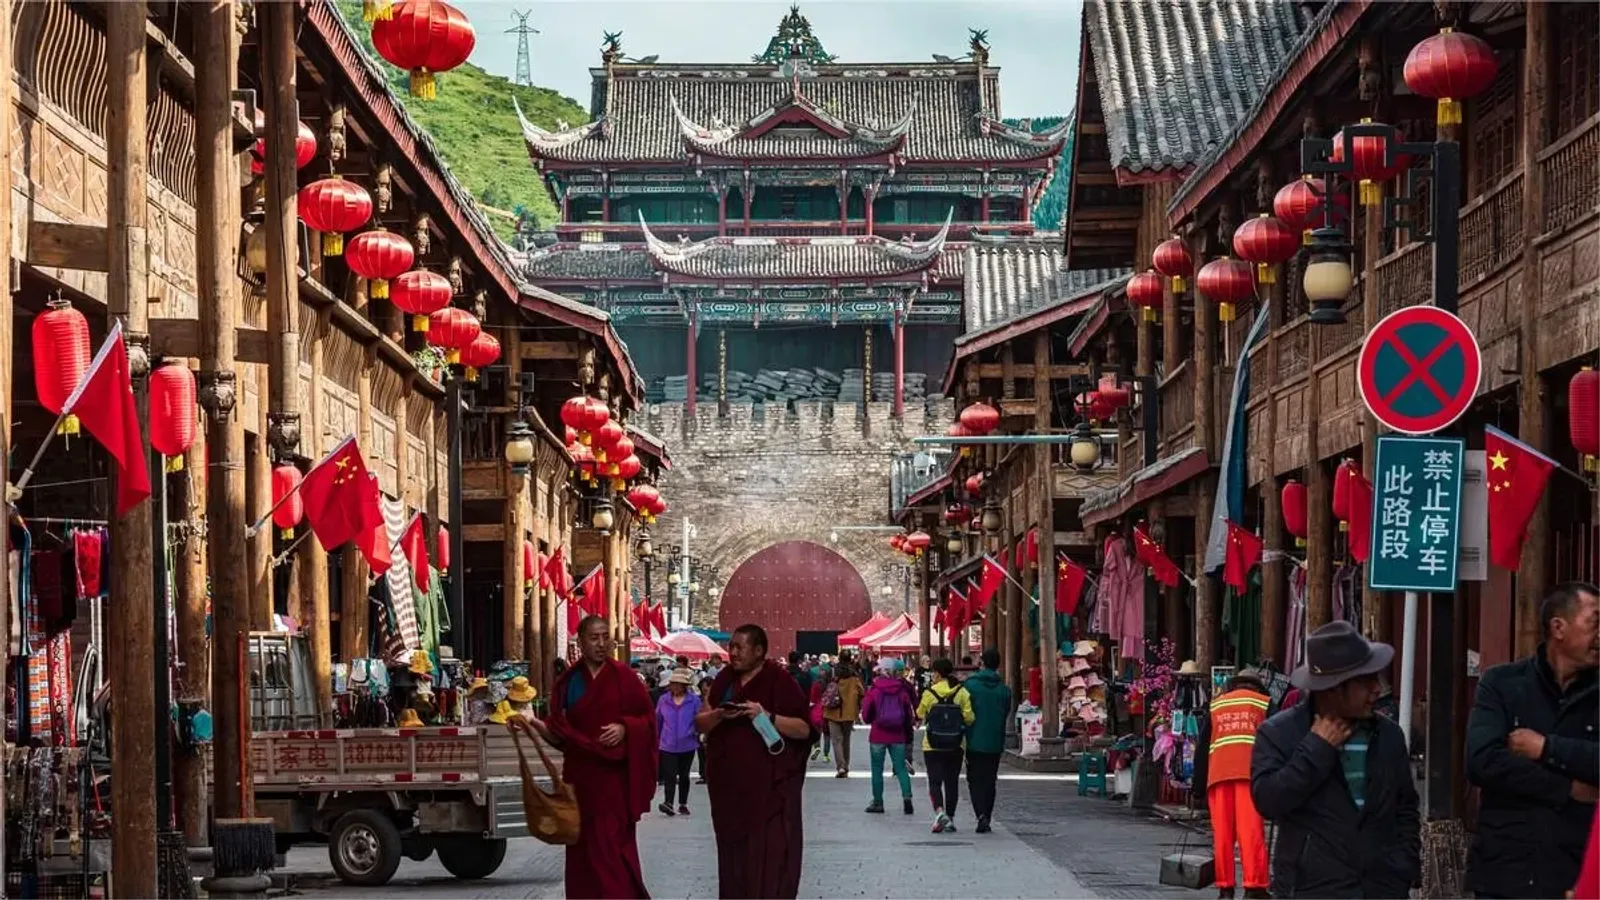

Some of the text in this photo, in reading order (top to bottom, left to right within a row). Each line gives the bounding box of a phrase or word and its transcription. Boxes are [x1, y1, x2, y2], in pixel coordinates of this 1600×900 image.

[1380, 464, 1413, 560] 此路段
[1417, 449, 1453, 576] 禁止停车
